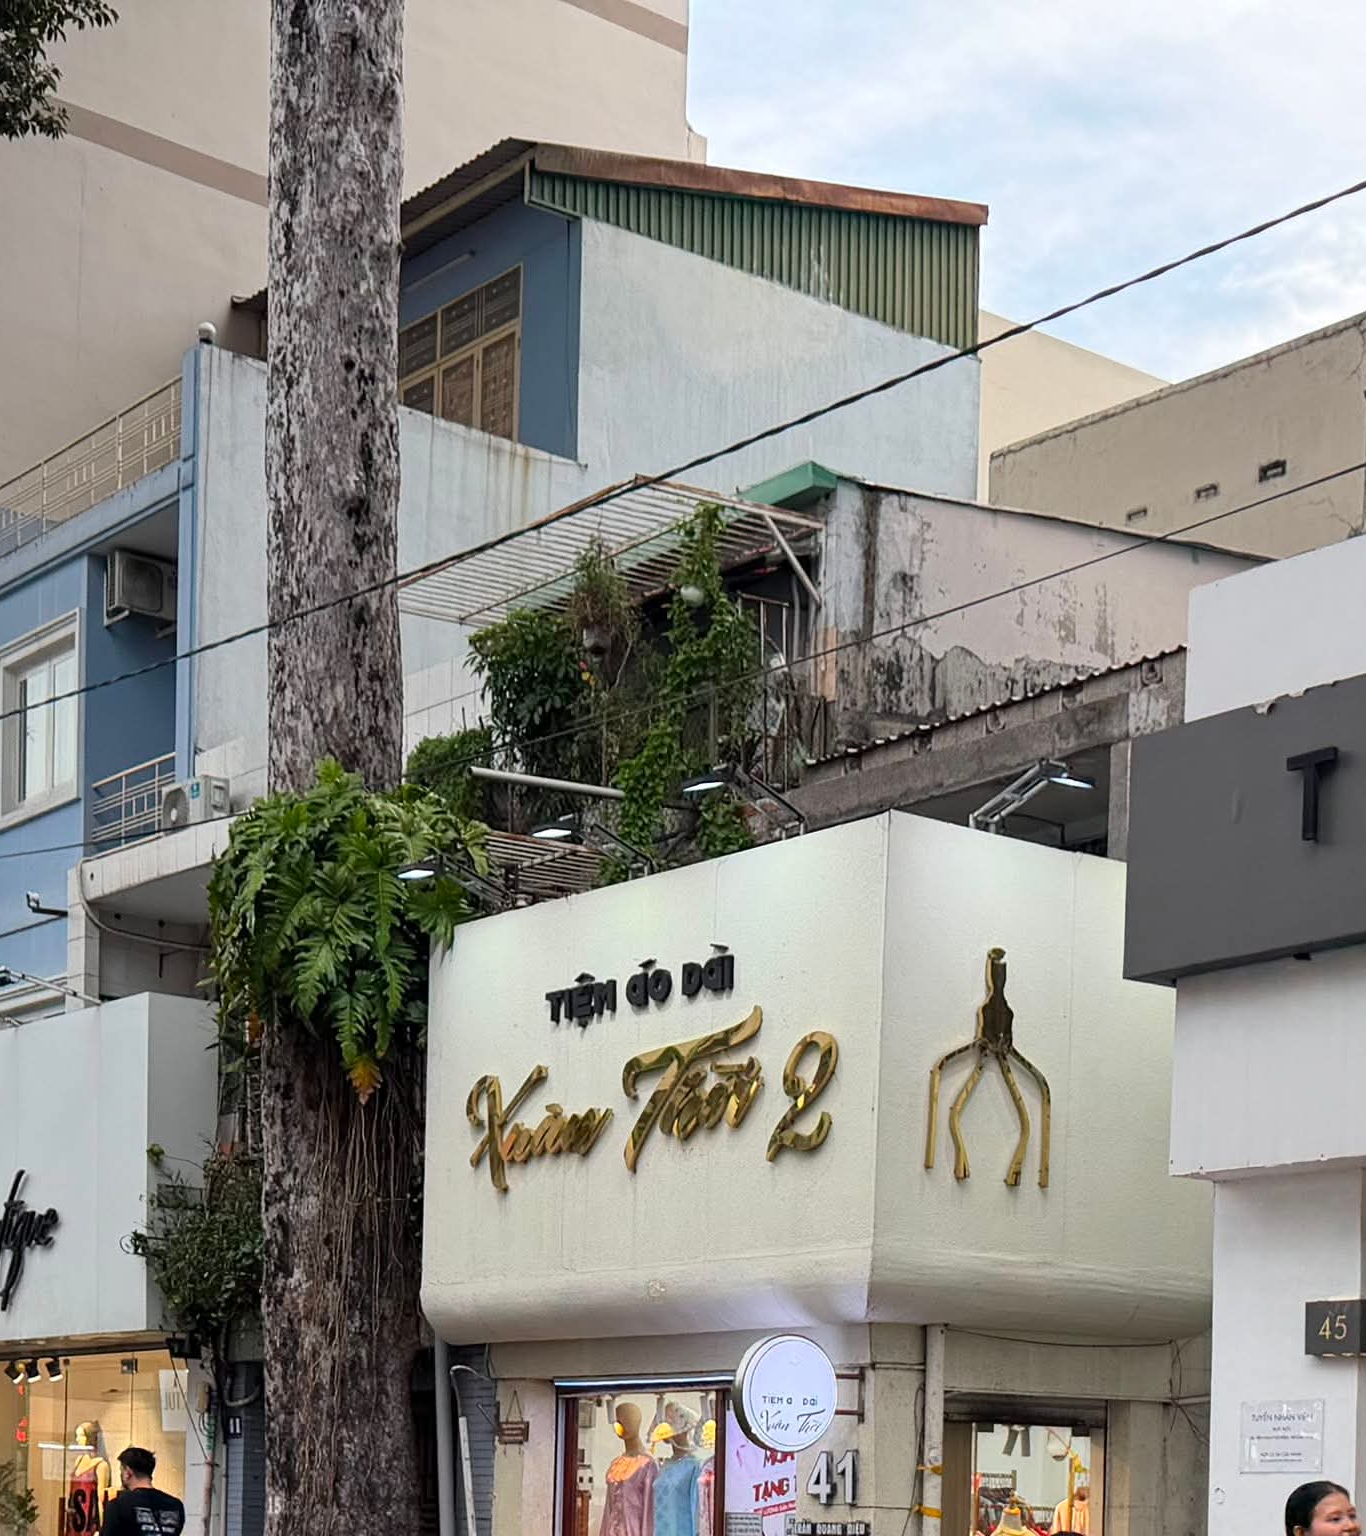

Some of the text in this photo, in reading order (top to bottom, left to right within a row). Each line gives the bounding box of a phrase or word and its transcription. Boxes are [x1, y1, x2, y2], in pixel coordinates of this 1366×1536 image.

[545, 972, 617, 1029] TIỆM
[466, 1064, 615, 1193] Xuân
[766, 1030, 839, 1163] 2
[1318, 1314, 1348, 1340] 45
[807, 1450, 860, 1506] 41
